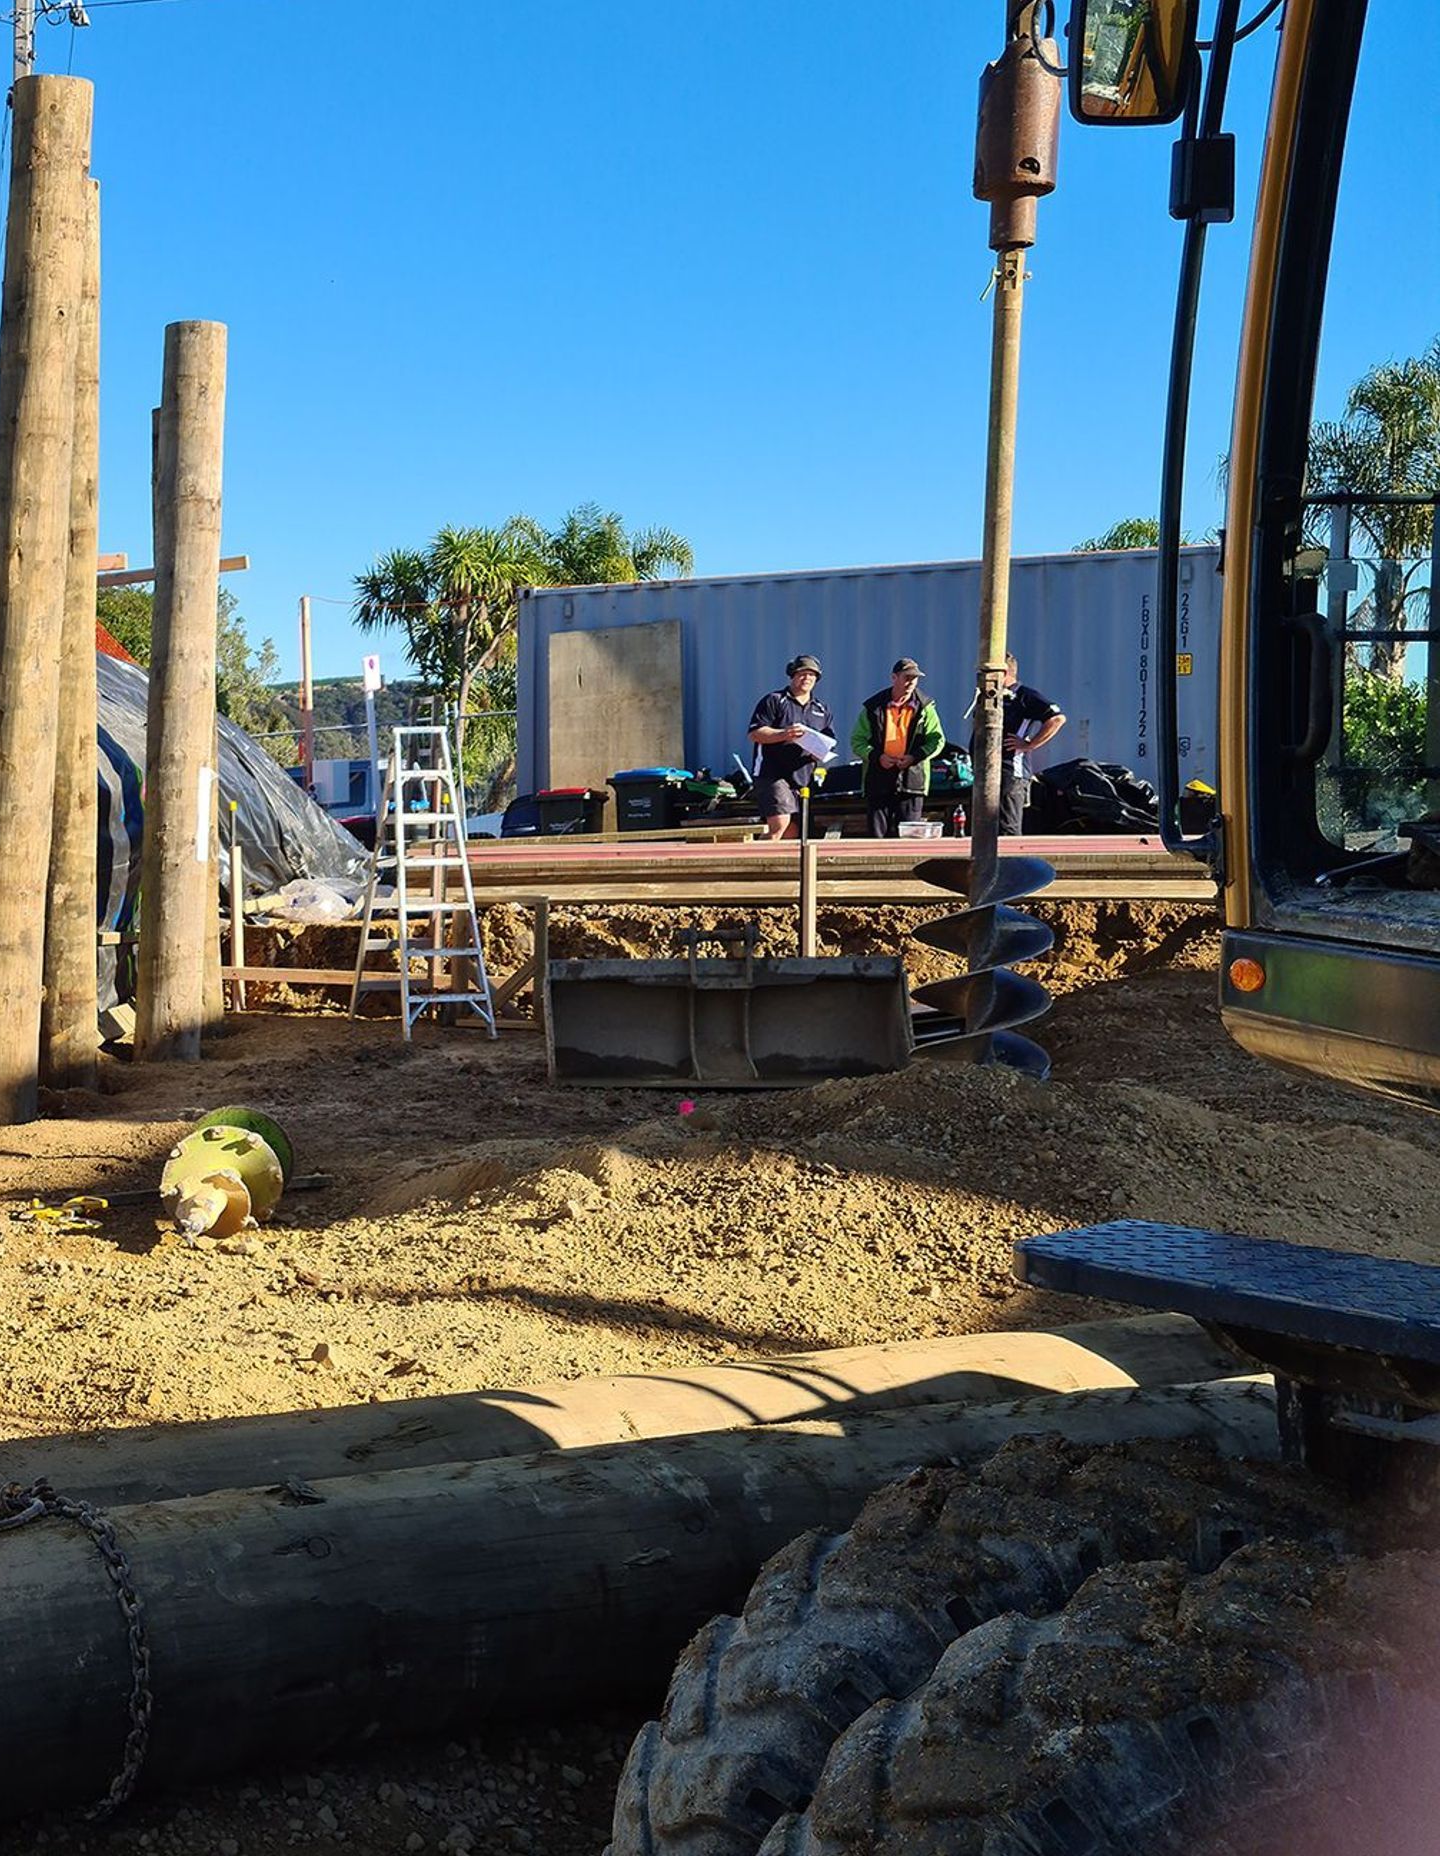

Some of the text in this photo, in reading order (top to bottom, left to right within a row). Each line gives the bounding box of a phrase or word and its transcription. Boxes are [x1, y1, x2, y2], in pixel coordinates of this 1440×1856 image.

[1137, 594, 1151, 757] FBXU 801122 8
[1180, 592, 1190, 649] 22G1
